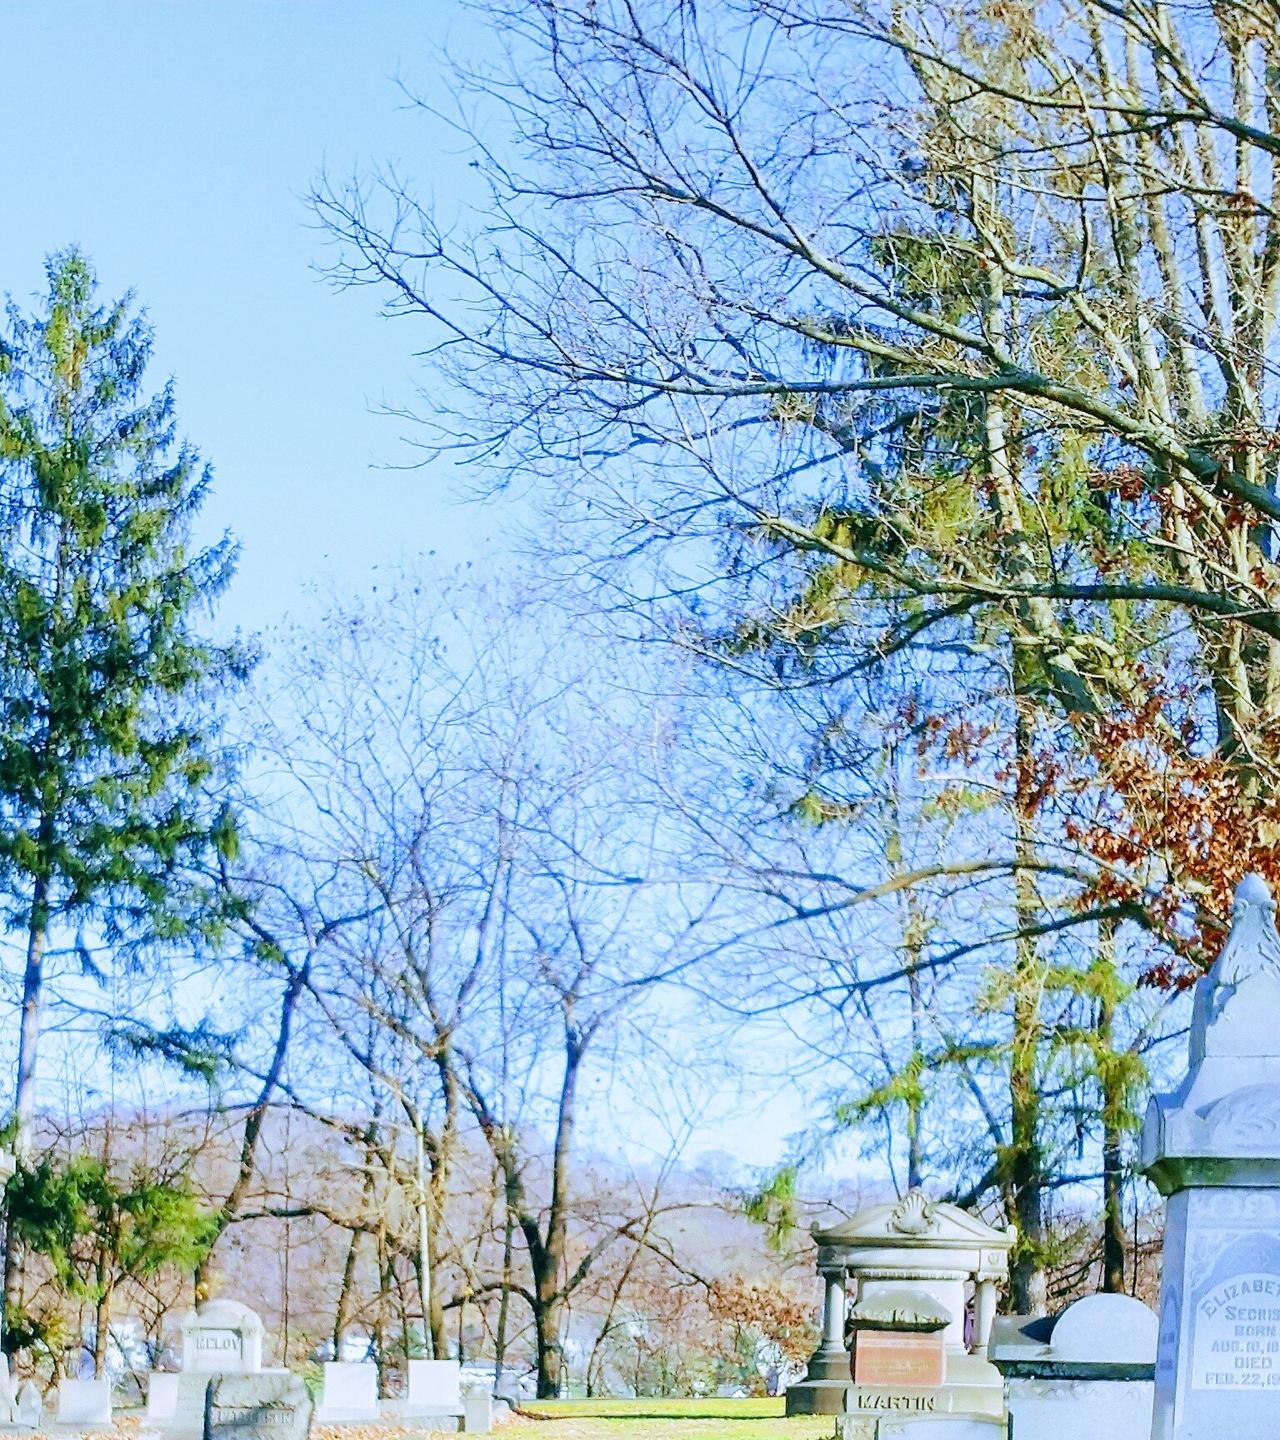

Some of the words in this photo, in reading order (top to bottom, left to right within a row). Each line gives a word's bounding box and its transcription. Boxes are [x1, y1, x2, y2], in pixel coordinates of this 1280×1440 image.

[1234, 1325, 1277, 1337] BORN
[1234, 1356, 1273, 1369] DIED
[857, 1394, 936, 1412] MARTIN
